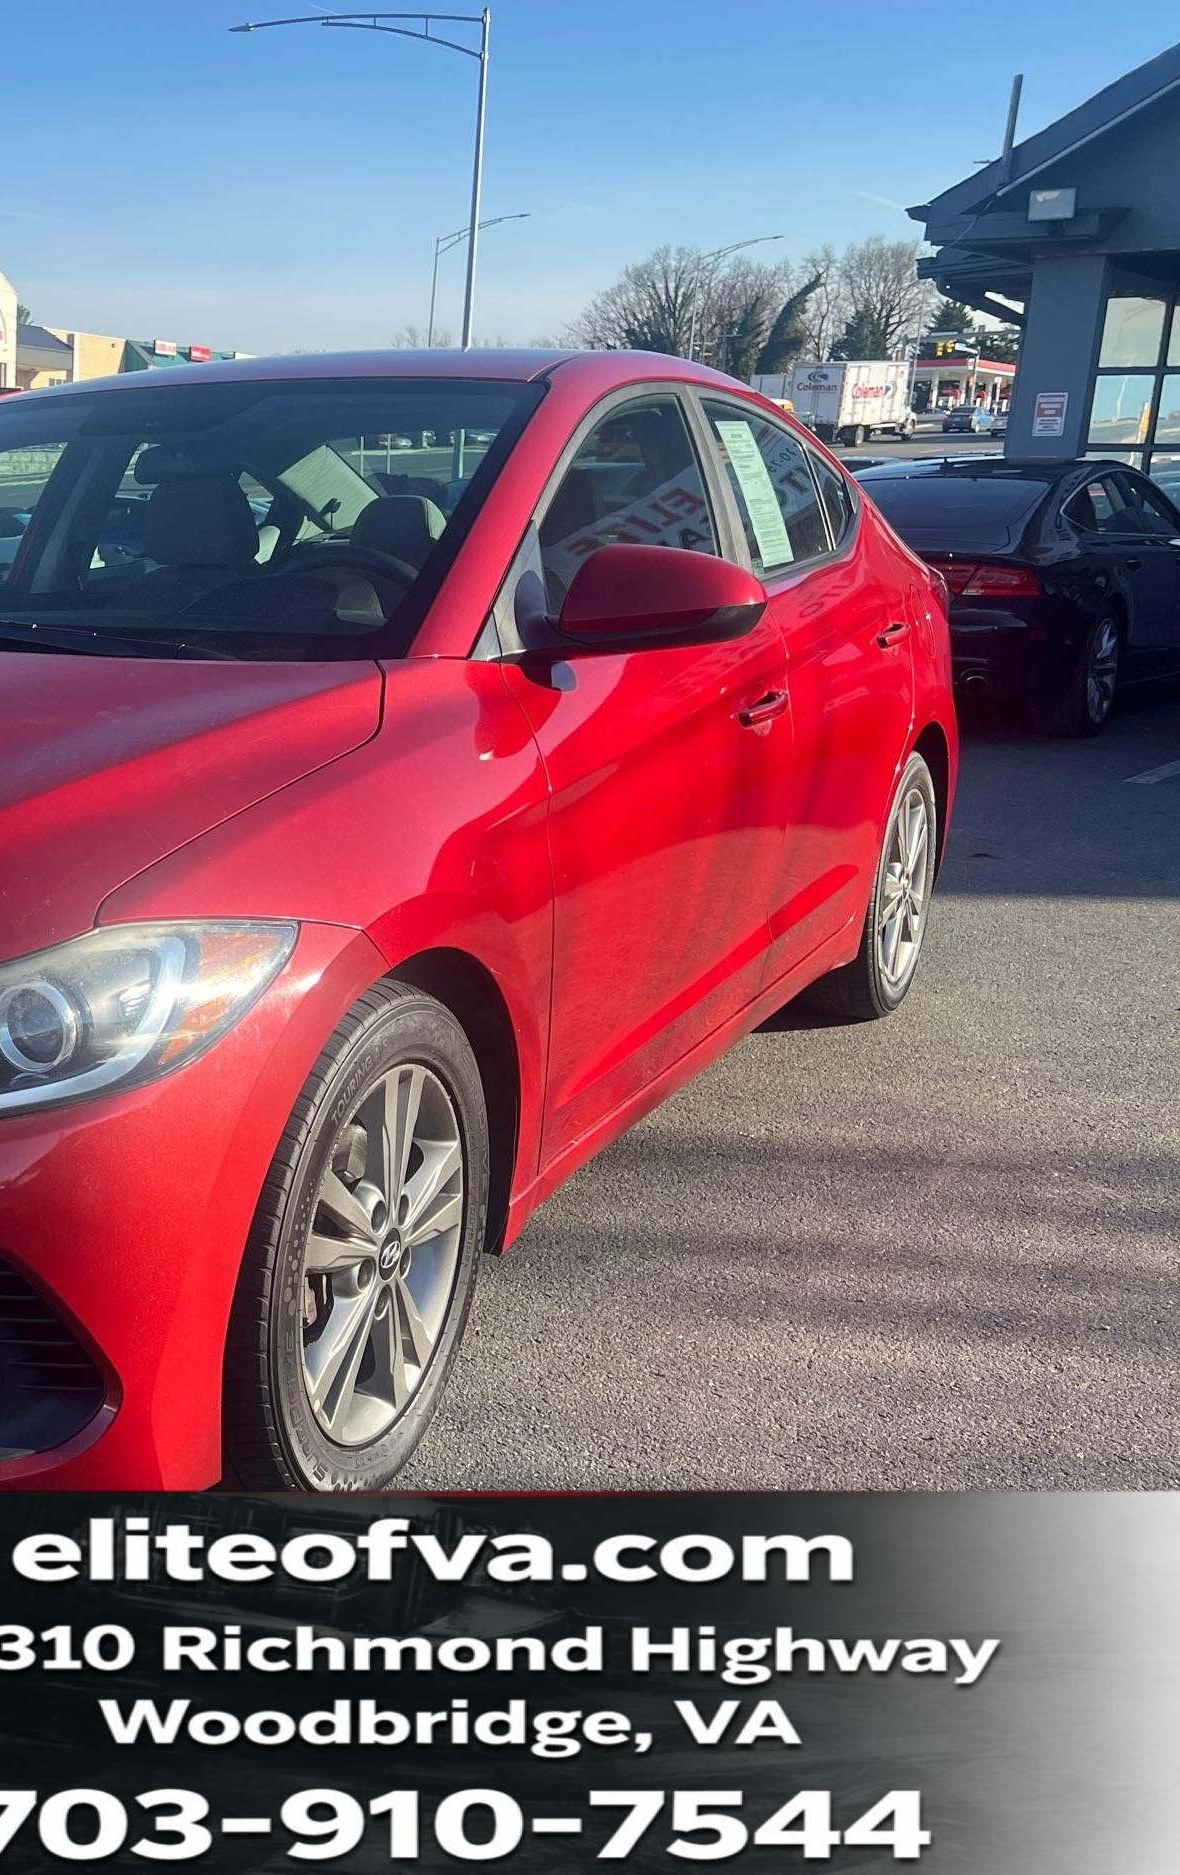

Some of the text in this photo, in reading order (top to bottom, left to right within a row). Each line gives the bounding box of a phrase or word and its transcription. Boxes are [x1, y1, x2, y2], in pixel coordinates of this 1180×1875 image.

[797, 382, 837, 392] Coleman
[851, 382, 885, 400] Coleman
[331, 1056, 372, 1125] TOURING
